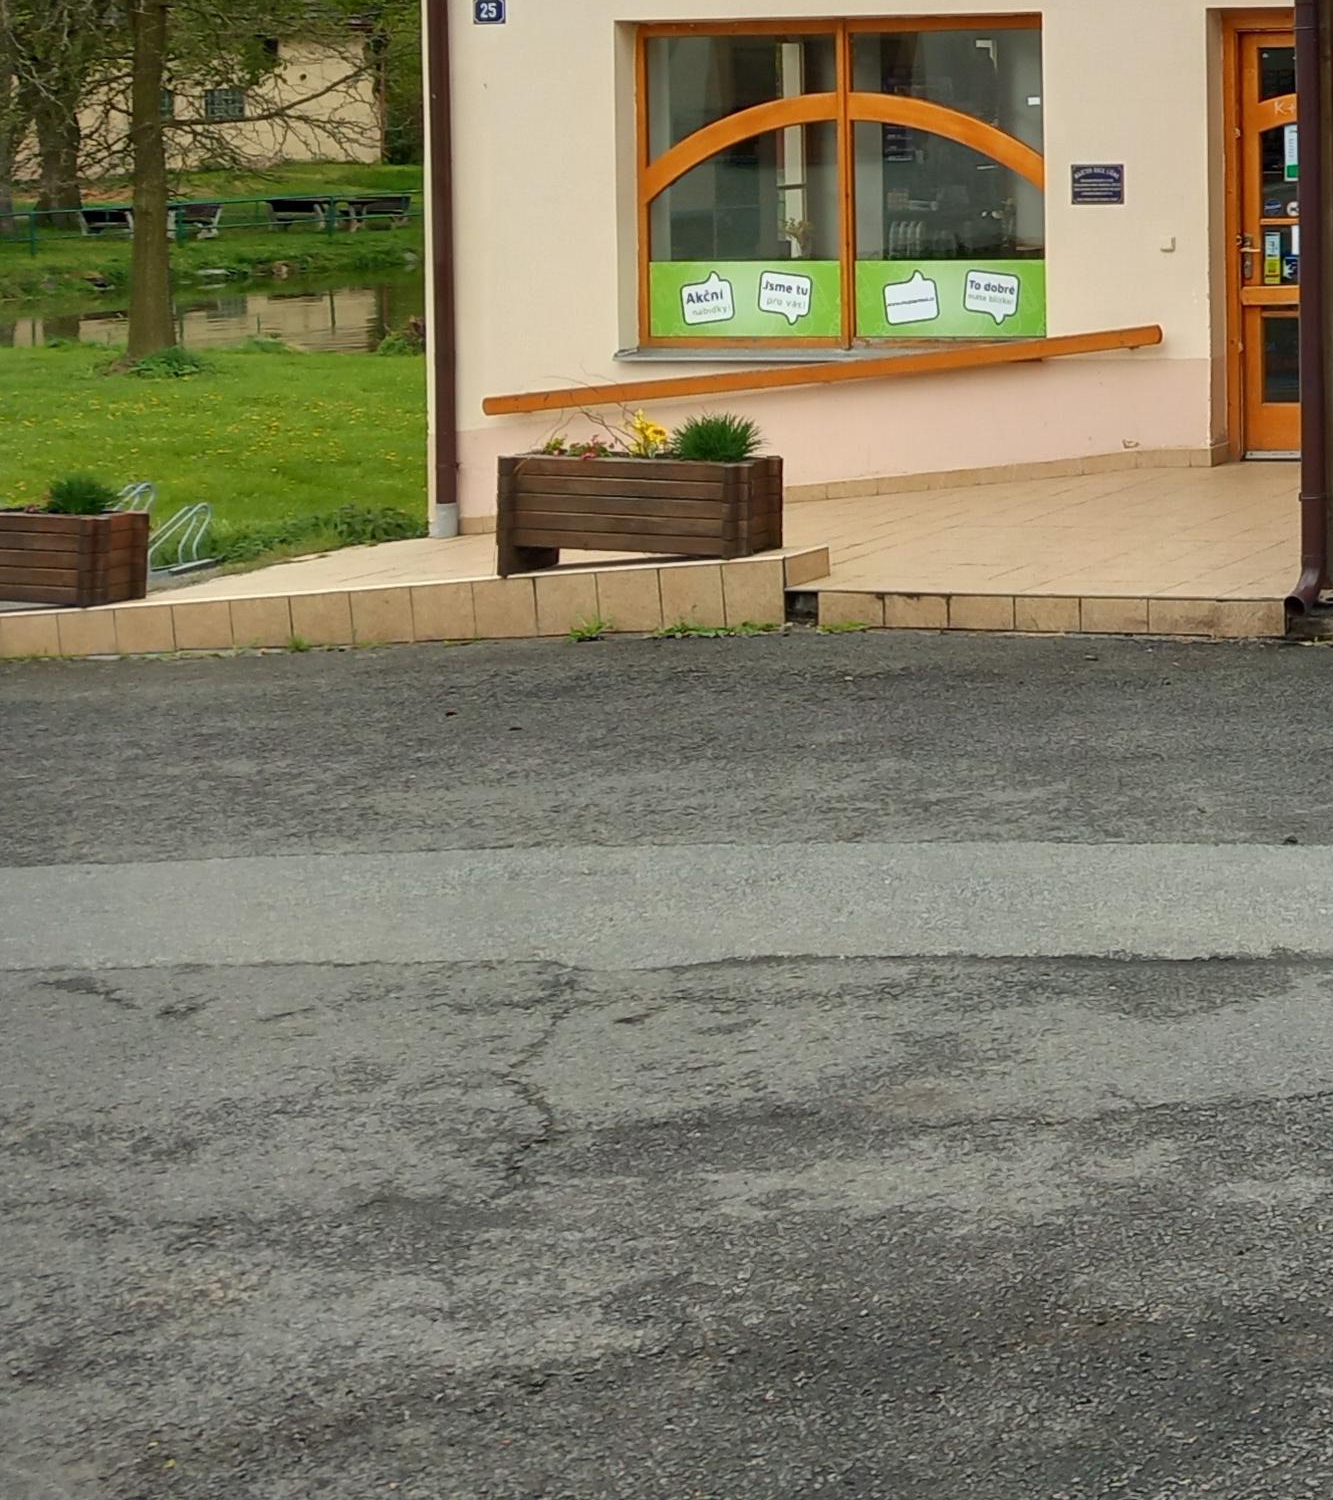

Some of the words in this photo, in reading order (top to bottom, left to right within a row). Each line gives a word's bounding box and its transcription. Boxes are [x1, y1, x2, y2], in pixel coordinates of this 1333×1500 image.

[480, 2, 497, 19] 25
[763, 280, 793, 294] Jsme
[796, 285, 808, 296] tu
[969, 280, 981, 290] To
[984, 282, 1015, 295] dobré
[686, 289, 724, 305] Akční
